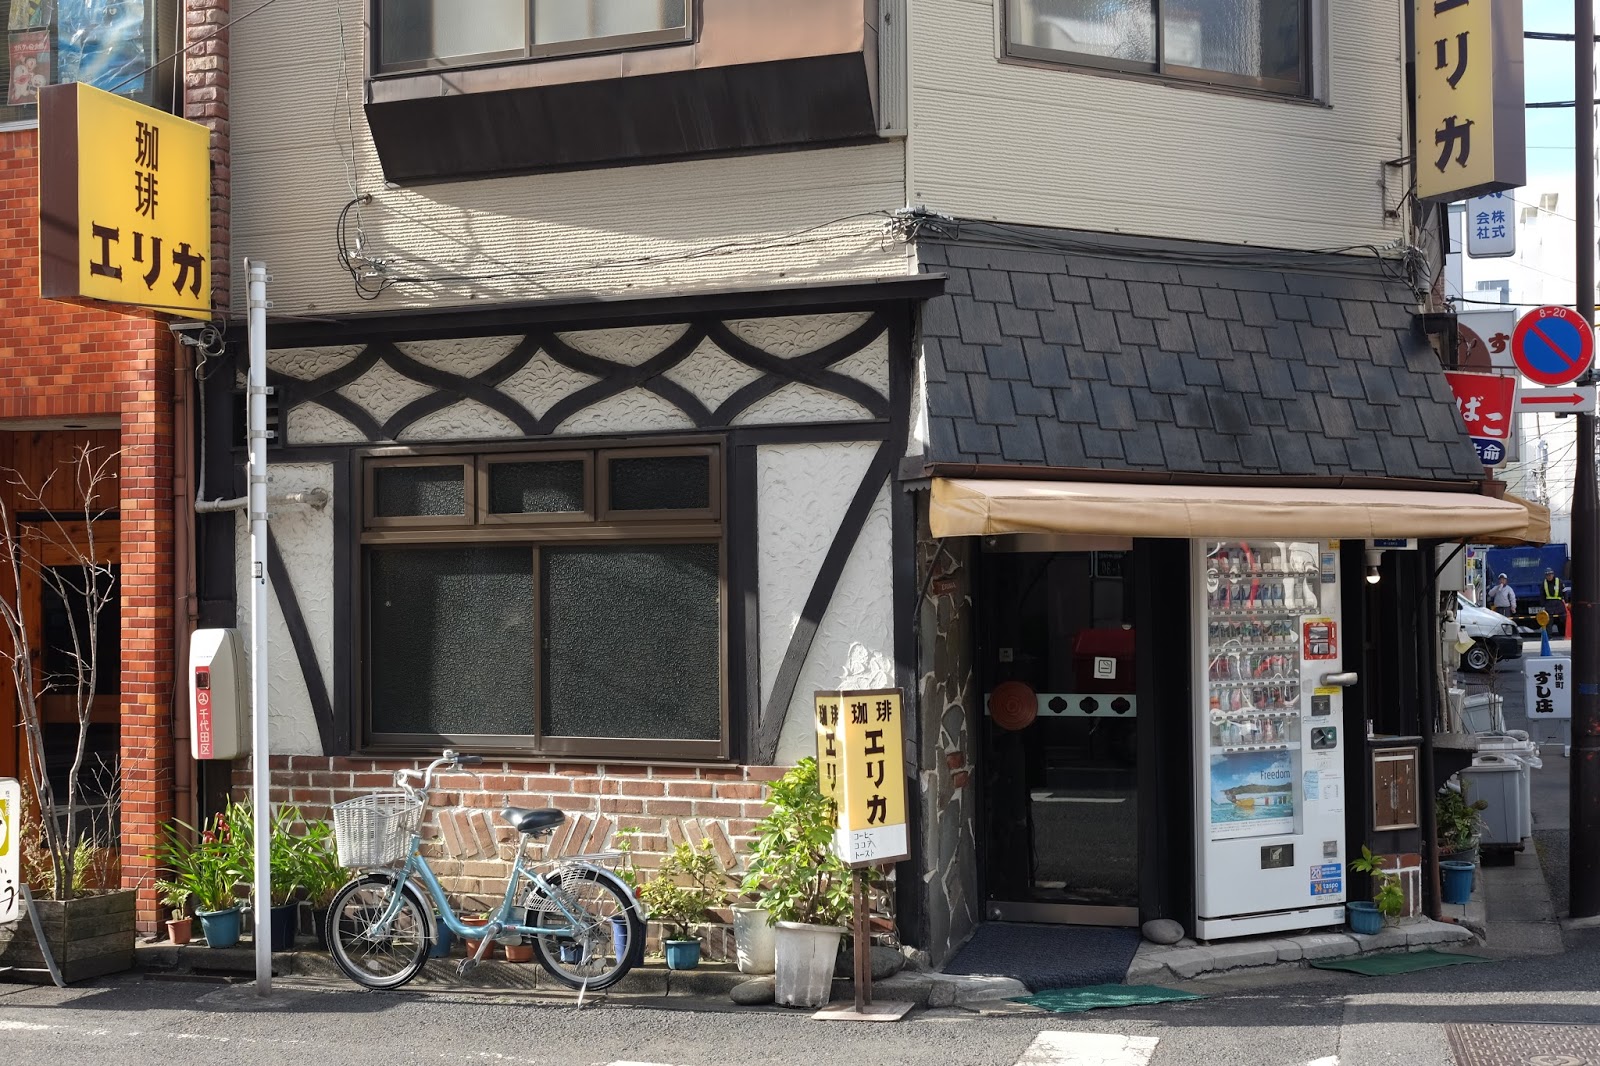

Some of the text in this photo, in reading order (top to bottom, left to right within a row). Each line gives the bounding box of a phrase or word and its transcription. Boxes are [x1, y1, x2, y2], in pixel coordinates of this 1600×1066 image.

[135, 120, 159, 220] 珈琲
[1476, 211, 1490, 240] 会社
[1491, 210, 1506, 239] 株式
[90, 220, 206, 300] エリカ
[1539, 307, 1567, 319] 8-20
[1488, 332, 1509, 354] す
[1450, 386, 1504, 436] ばこ
[1554, 663, 1564, 689] 神保町
[1533, 671, 1554, 713] すし庄
[850, 699, 892, 725] 珈琲
[199, 708, 210, 755] 千代田区
[864, 728, 888, 826] エリカ
[1260, 769, 1291, 780] Freedom
[854, 831, 874, 841] コーヒー
[855, 849, 875, 860] トースト
[1323, 882, 1339, 890] taspo
